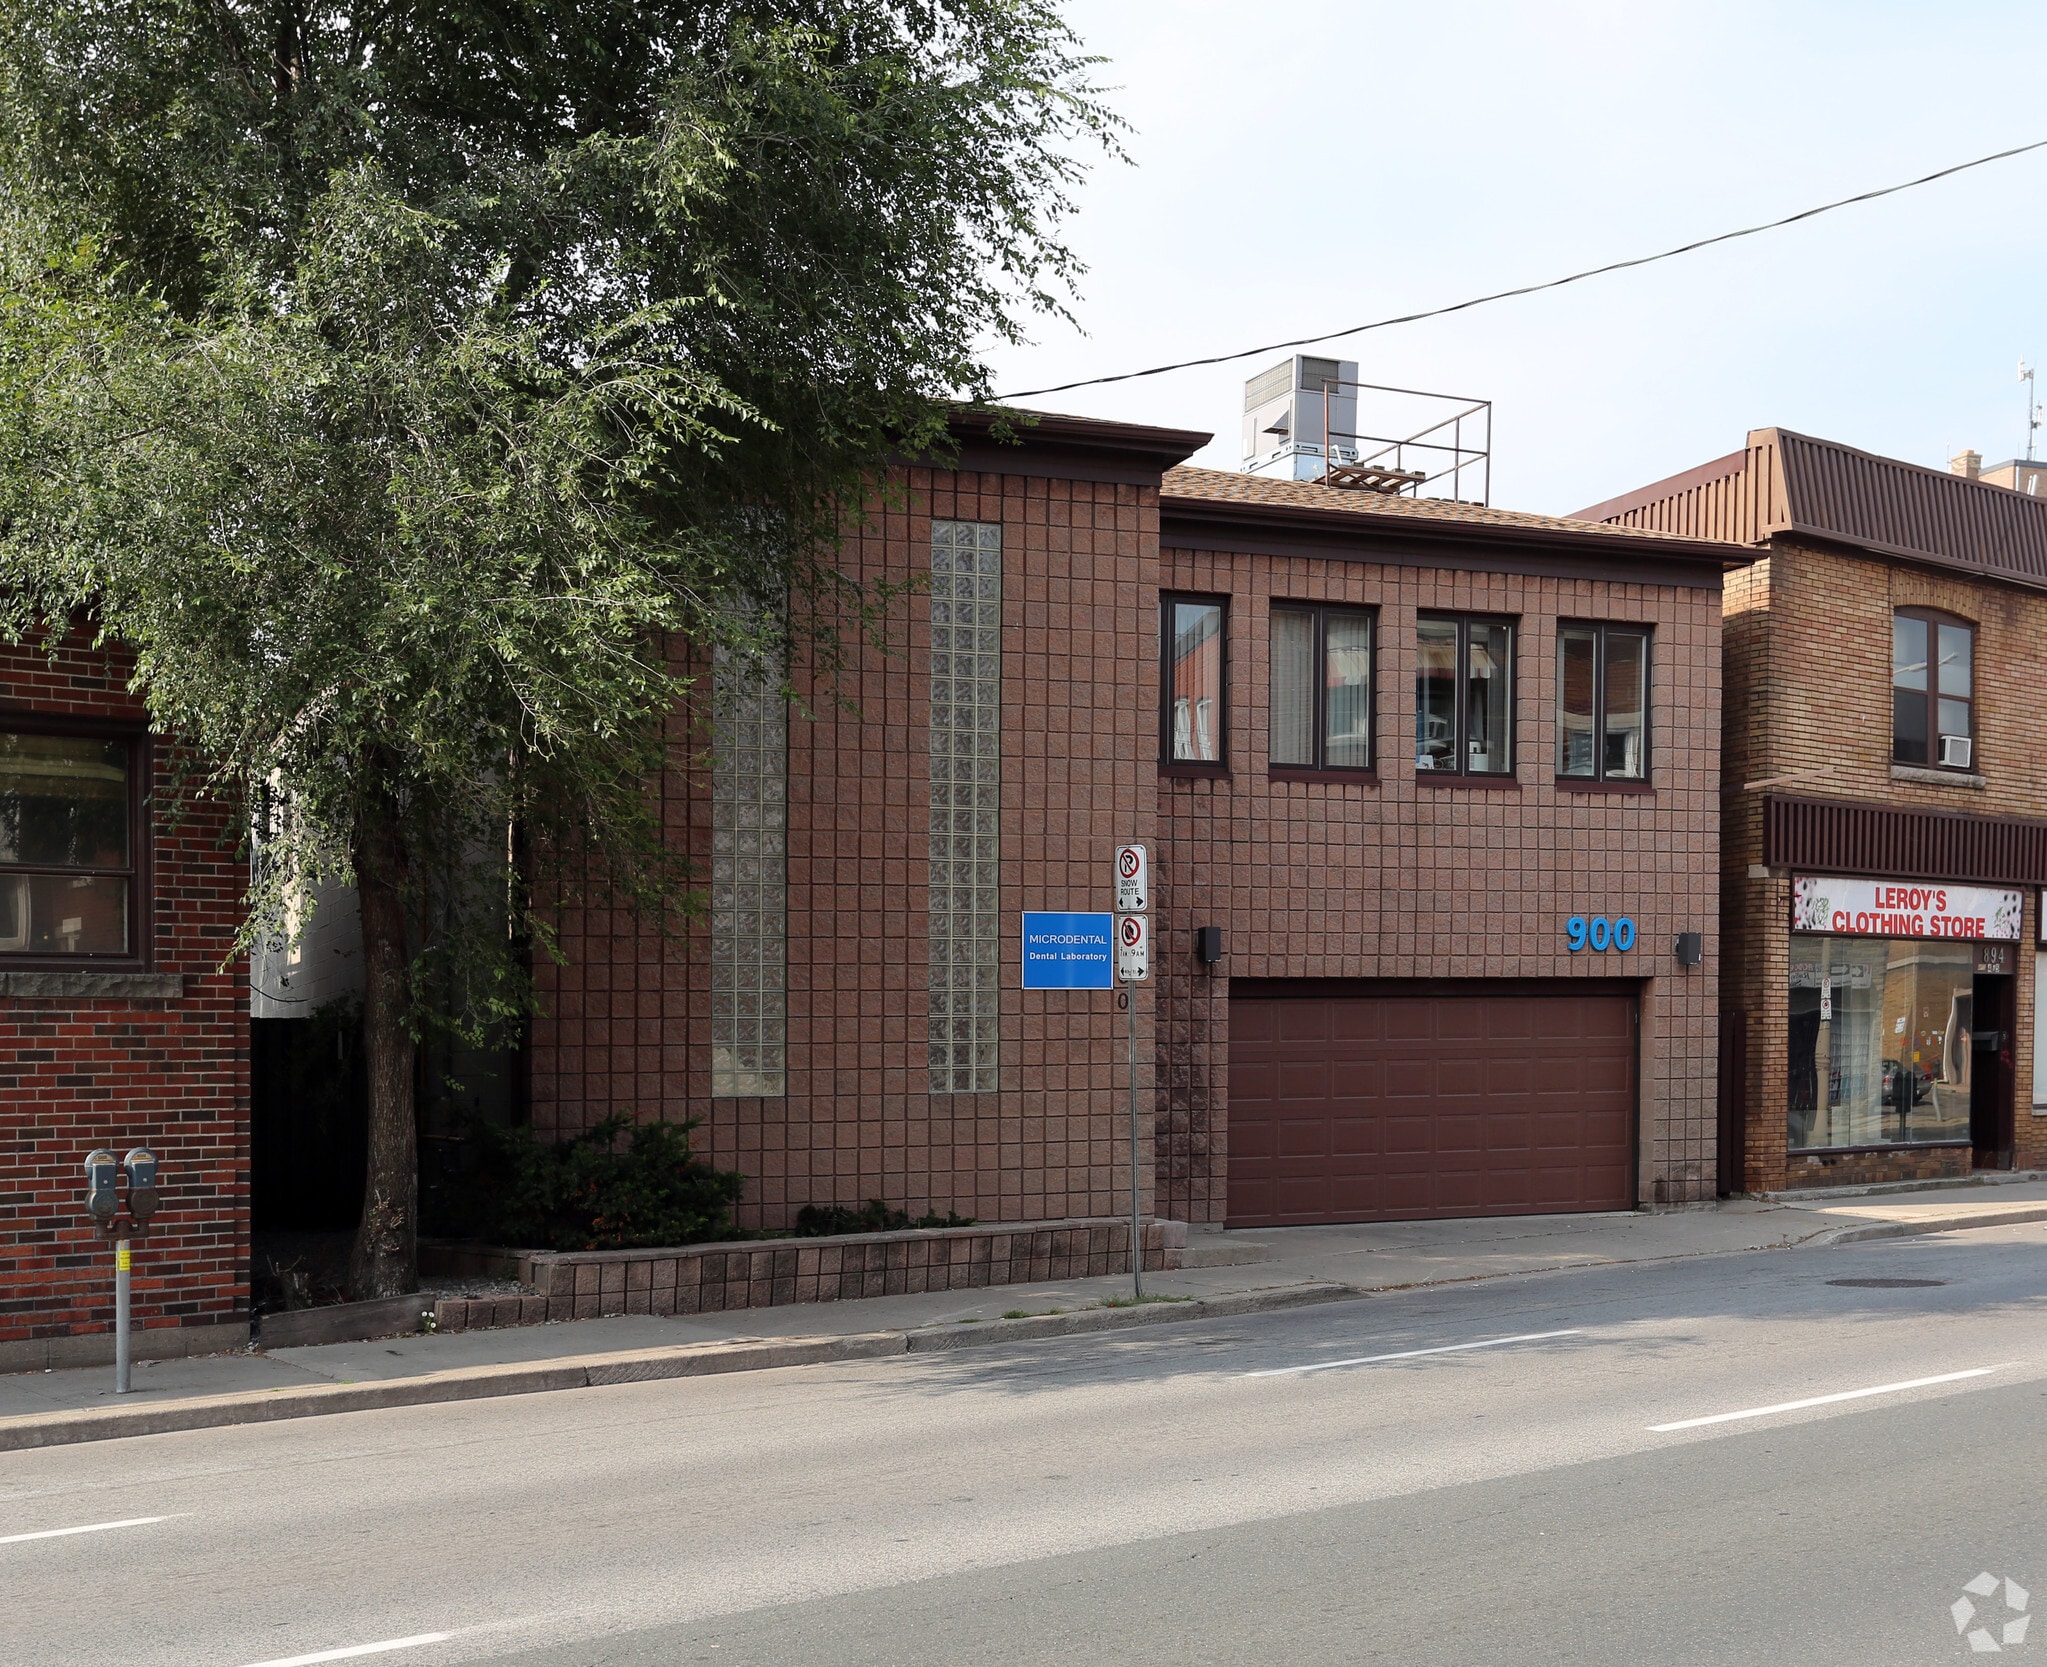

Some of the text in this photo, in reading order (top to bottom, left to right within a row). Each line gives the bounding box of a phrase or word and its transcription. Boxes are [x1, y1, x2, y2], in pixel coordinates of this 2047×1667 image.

[1875, 887, 1947, 911] LEROY'S
[1566, 916, 1636, 951] 900
[1832, 911, 1986, 938] CLOTHING STORE
[1029, 935, 1107, 944] MICRODENTAL
[1029, 952, 1107, 962] Dental Laboratory
[1983, 947, 2005, 963] 894
